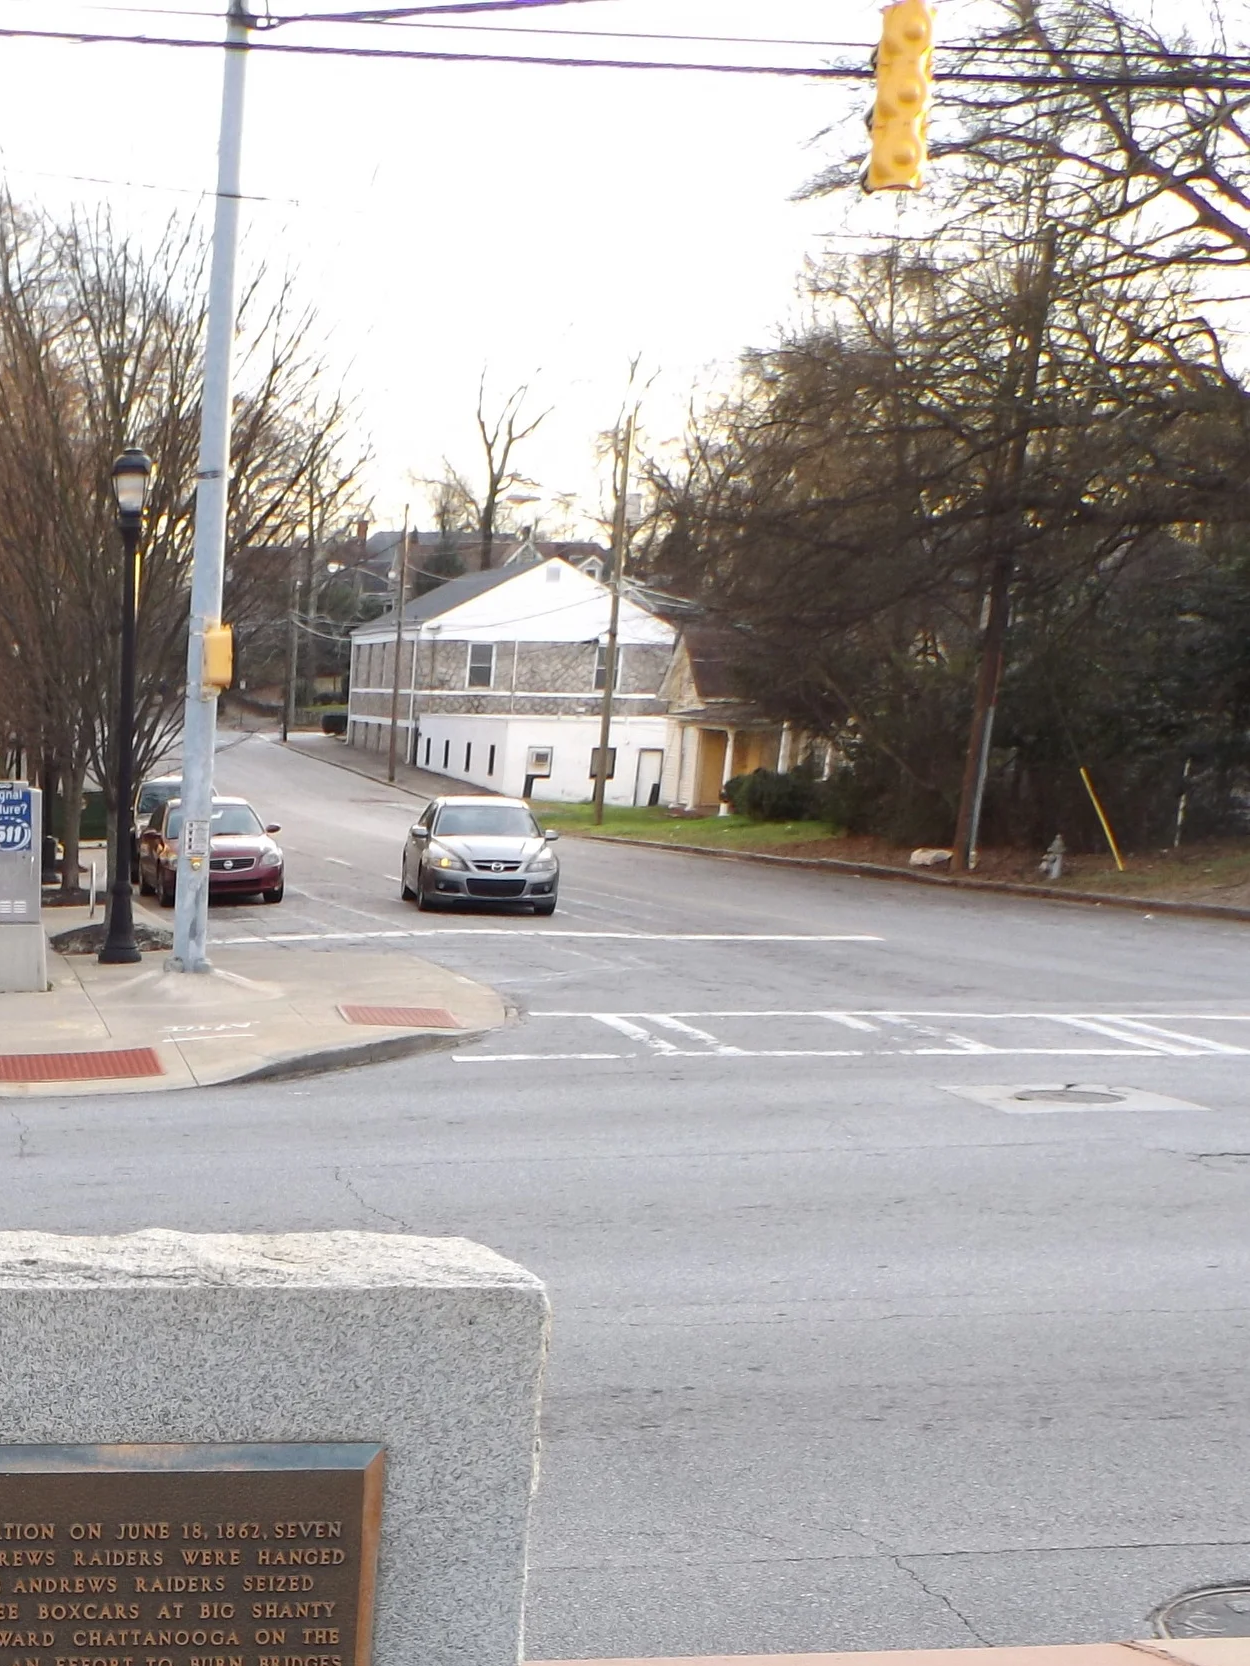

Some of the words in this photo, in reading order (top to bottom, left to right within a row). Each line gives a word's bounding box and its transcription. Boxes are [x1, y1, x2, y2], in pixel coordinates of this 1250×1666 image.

[68, 1523, 102, 1539] ON
[116, 1521, 170, 1539] JUNE
[182, 1522, 209, 1540] 18,
[215, 1522, 268, 1539] 1862,
[274, 1520, 342, 1538] SEVEN
[72, 1549, 164, 1565] RAIDERS
[180, 1549, 241, 1565] WERE
[257, 1548, 346, 1564] HANGED
[11, 1576, 118, 1593] ANDREWS
[134, 1576, 226, 1592] RAIDERS
[242, 1574, 315, 1592] SEIZED
[37, 1603, 140, 1620] BOXCARS
[156, 1602, 184, 1618] AT
[199, 1602, 236, 1618] BIG
[251, 1601, 336, 1618] SHANTY
[72, 1629, 241, 1646] CHATTANOOGA
[254, 1629, 287, 1644] ON
[301, 1627, 340, 1644] THE
